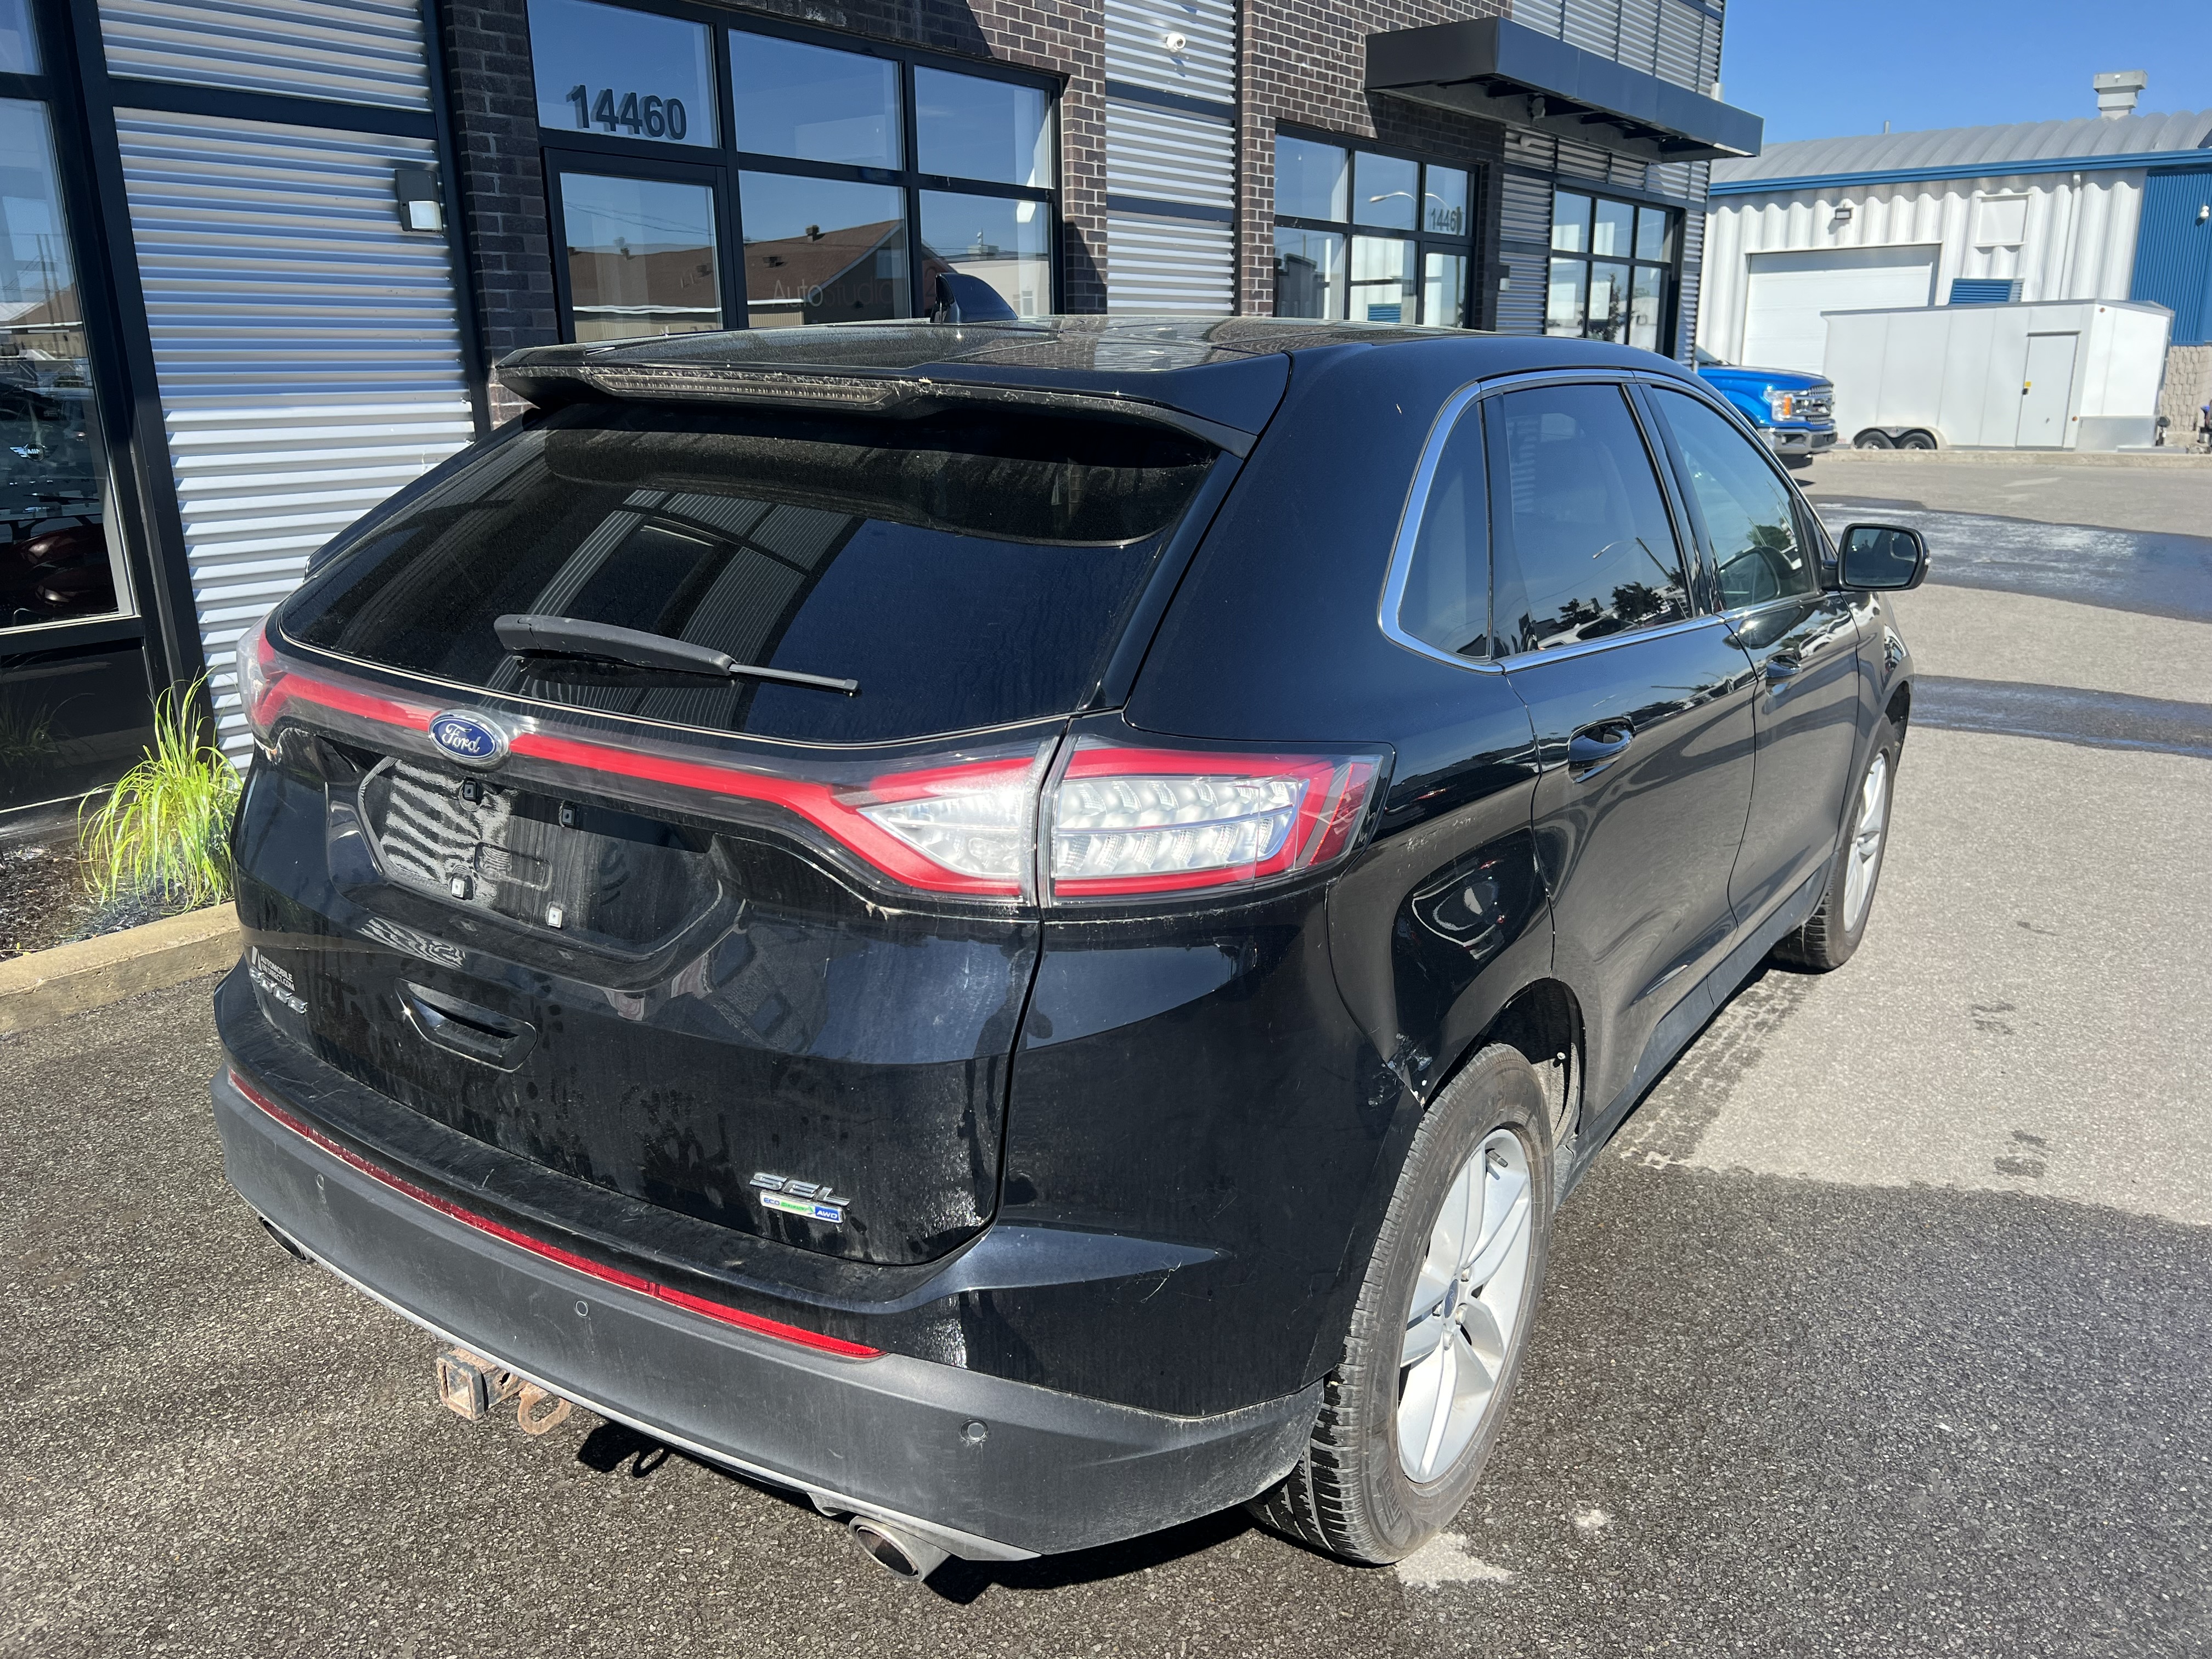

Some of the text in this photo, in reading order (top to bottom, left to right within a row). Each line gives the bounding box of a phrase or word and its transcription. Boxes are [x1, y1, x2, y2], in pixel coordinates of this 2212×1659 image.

[571, 84, 686, 140] 14460
[441, 723, 482, 754] Ford
[260, 954, 294, 983] AUTOMOBILE
[261, 962, 295, 992] EN DIRECT.COM
[749, 1172, 850, 1206] SEL
[763, 1197, 838, 1219] ECO AWD
